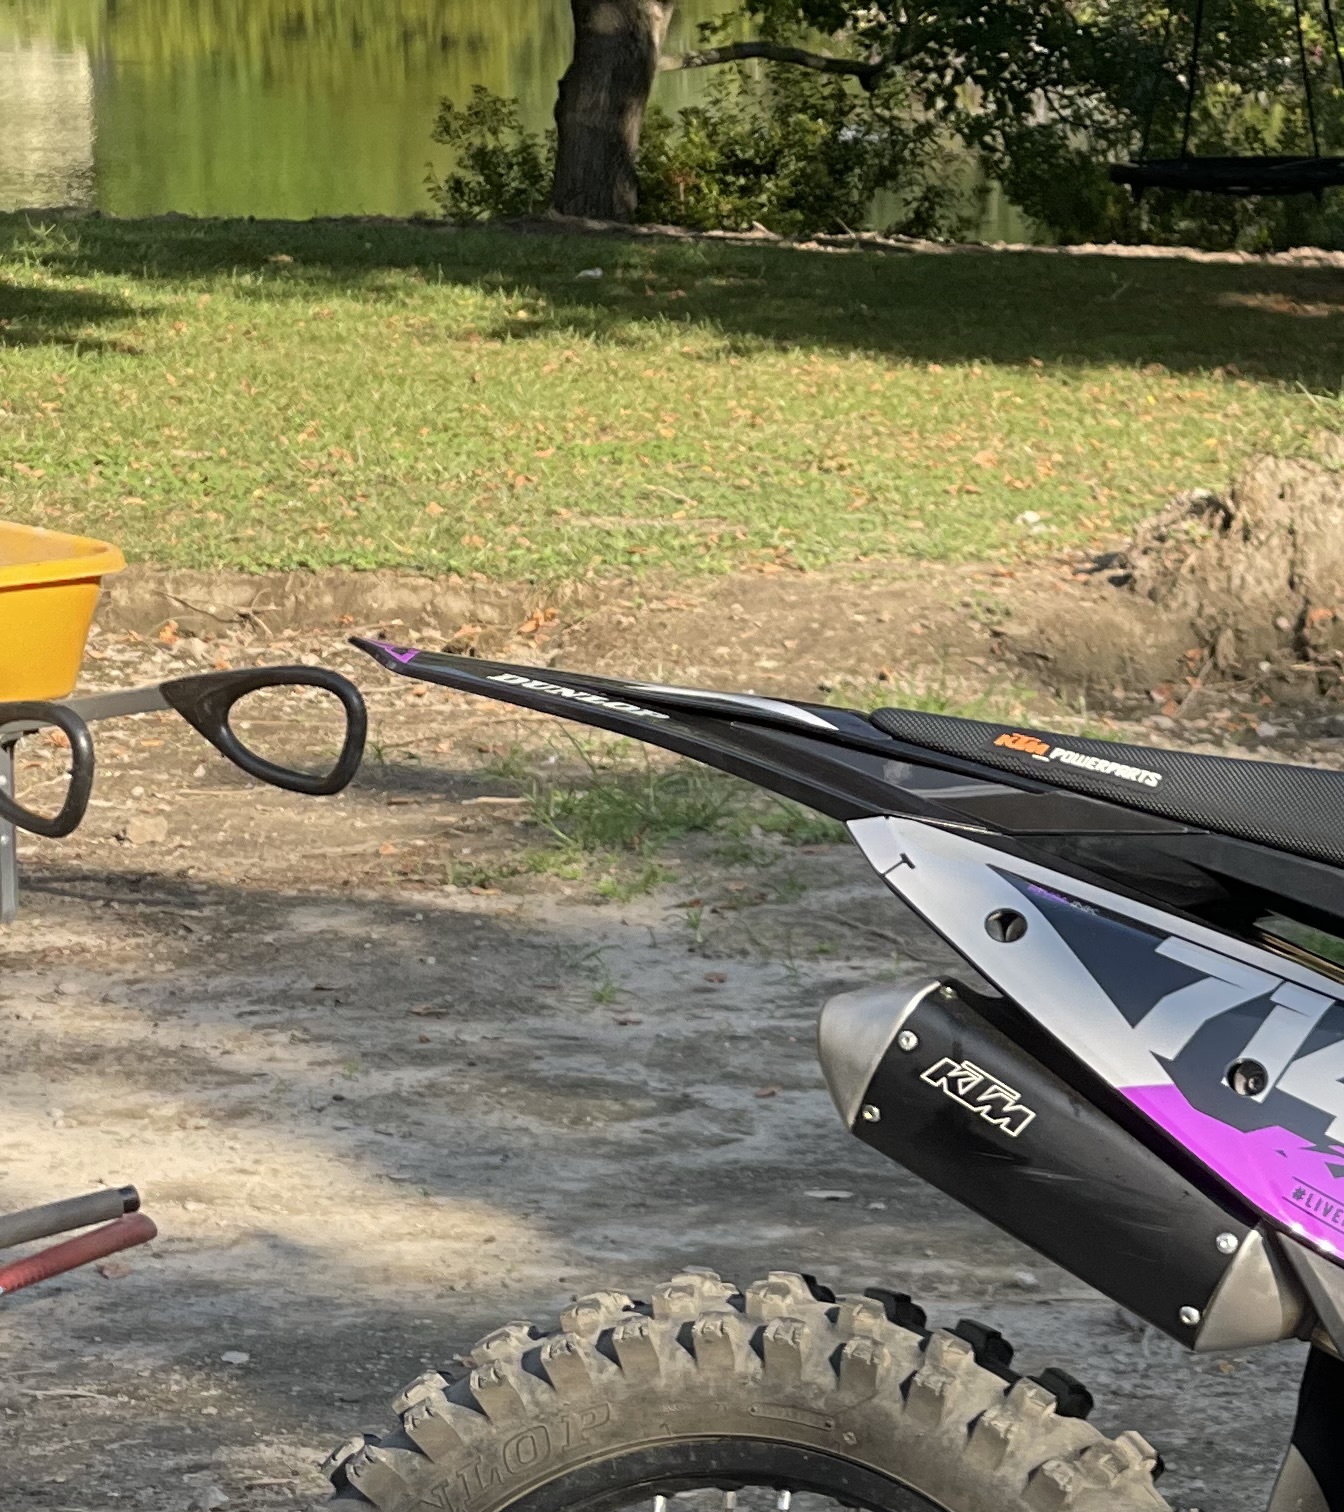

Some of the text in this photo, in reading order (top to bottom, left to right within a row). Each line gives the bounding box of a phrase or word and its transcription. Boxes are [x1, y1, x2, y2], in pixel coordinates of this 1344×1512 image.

[487, 672, 670, 722] DUNLOP
[994, 732, 1163, 787] KTM POWERPARTS
[920, 1057, 1037, 1138] KTM
